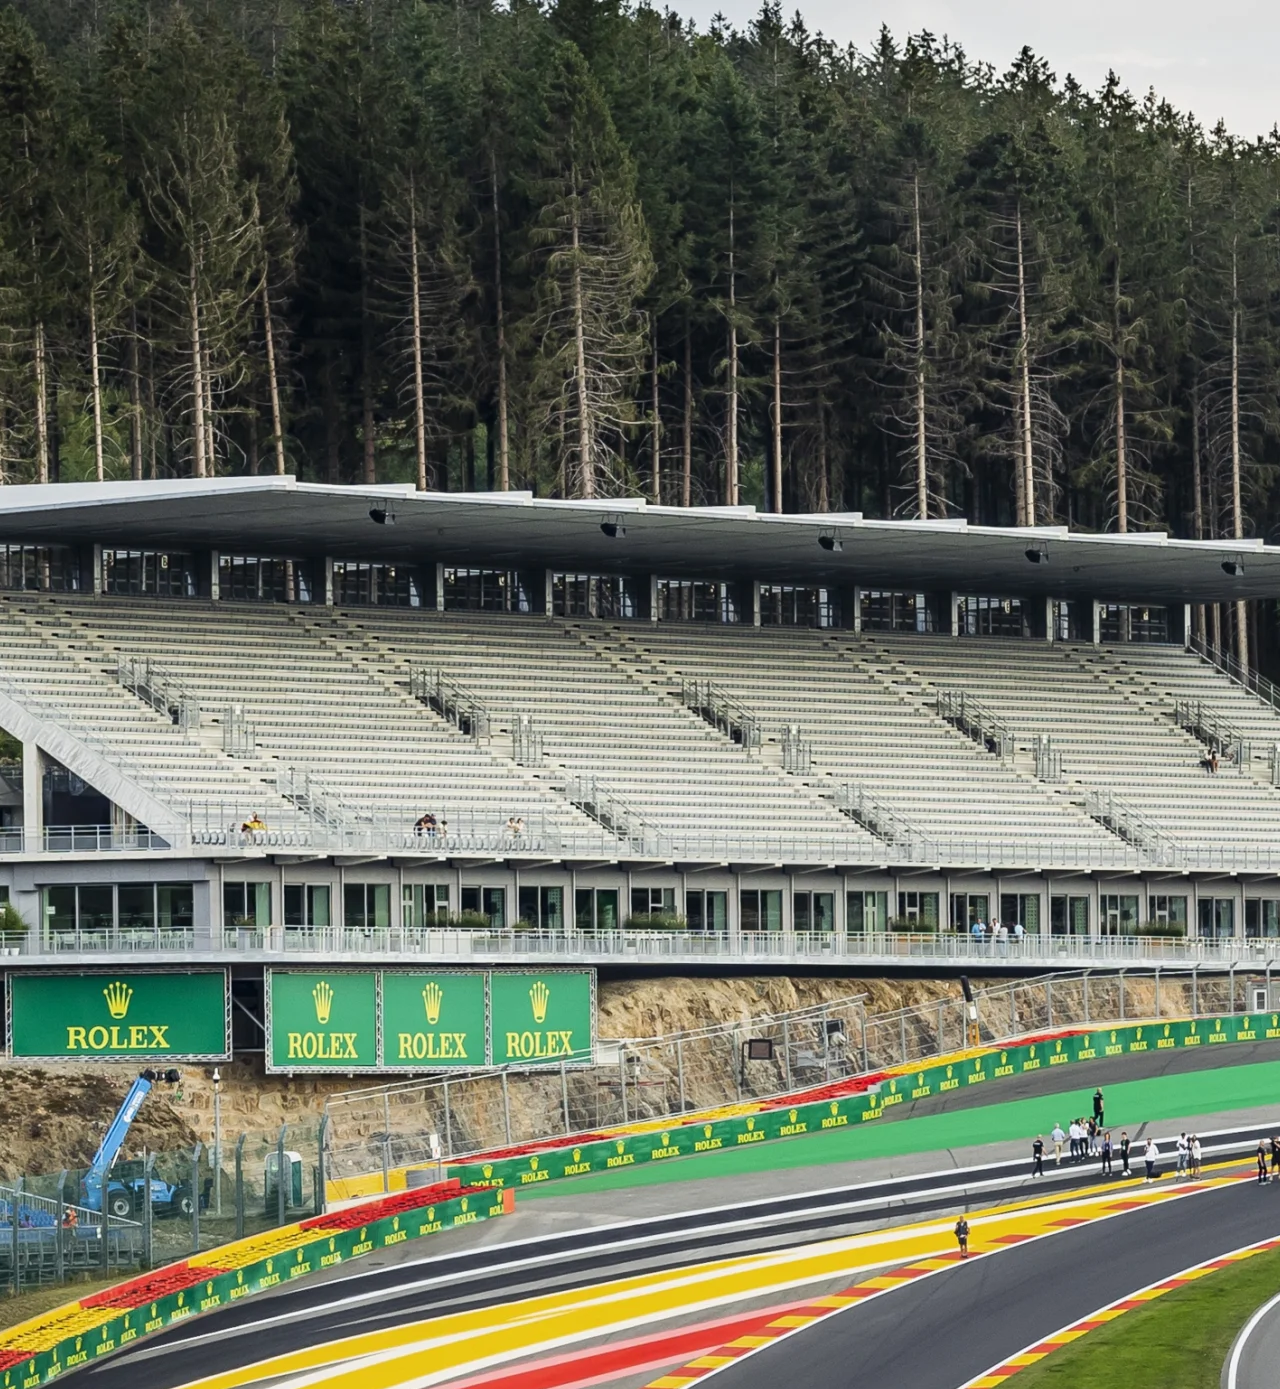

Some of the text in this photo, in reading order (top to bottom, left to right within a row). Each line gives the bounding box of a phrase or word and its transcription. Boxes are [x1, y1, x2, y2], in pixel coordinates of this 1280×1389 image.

[68, 1026, 169, 1049] ROLEX
[506, 1031, 573, 1057] ROLEX
[288, 1032, 358, 1059] ROLEX
[399, 1032, 467, 1059] ROLEX
[822, 1115, 848, 1128] ROLEX
[780, 1123, 807, 1136] ROLEX
[738, 1130, 764, 1144] ROLEX
[695, 1138, 722, 1151] ROLEX
[652, 1146, 680, 1159] ROLEX
[607, 1154, 634, 1168] ROLEX
[564, 1162, 590, 1176] ROLEX
[522, 1170, 549, 1184] ROLEX
